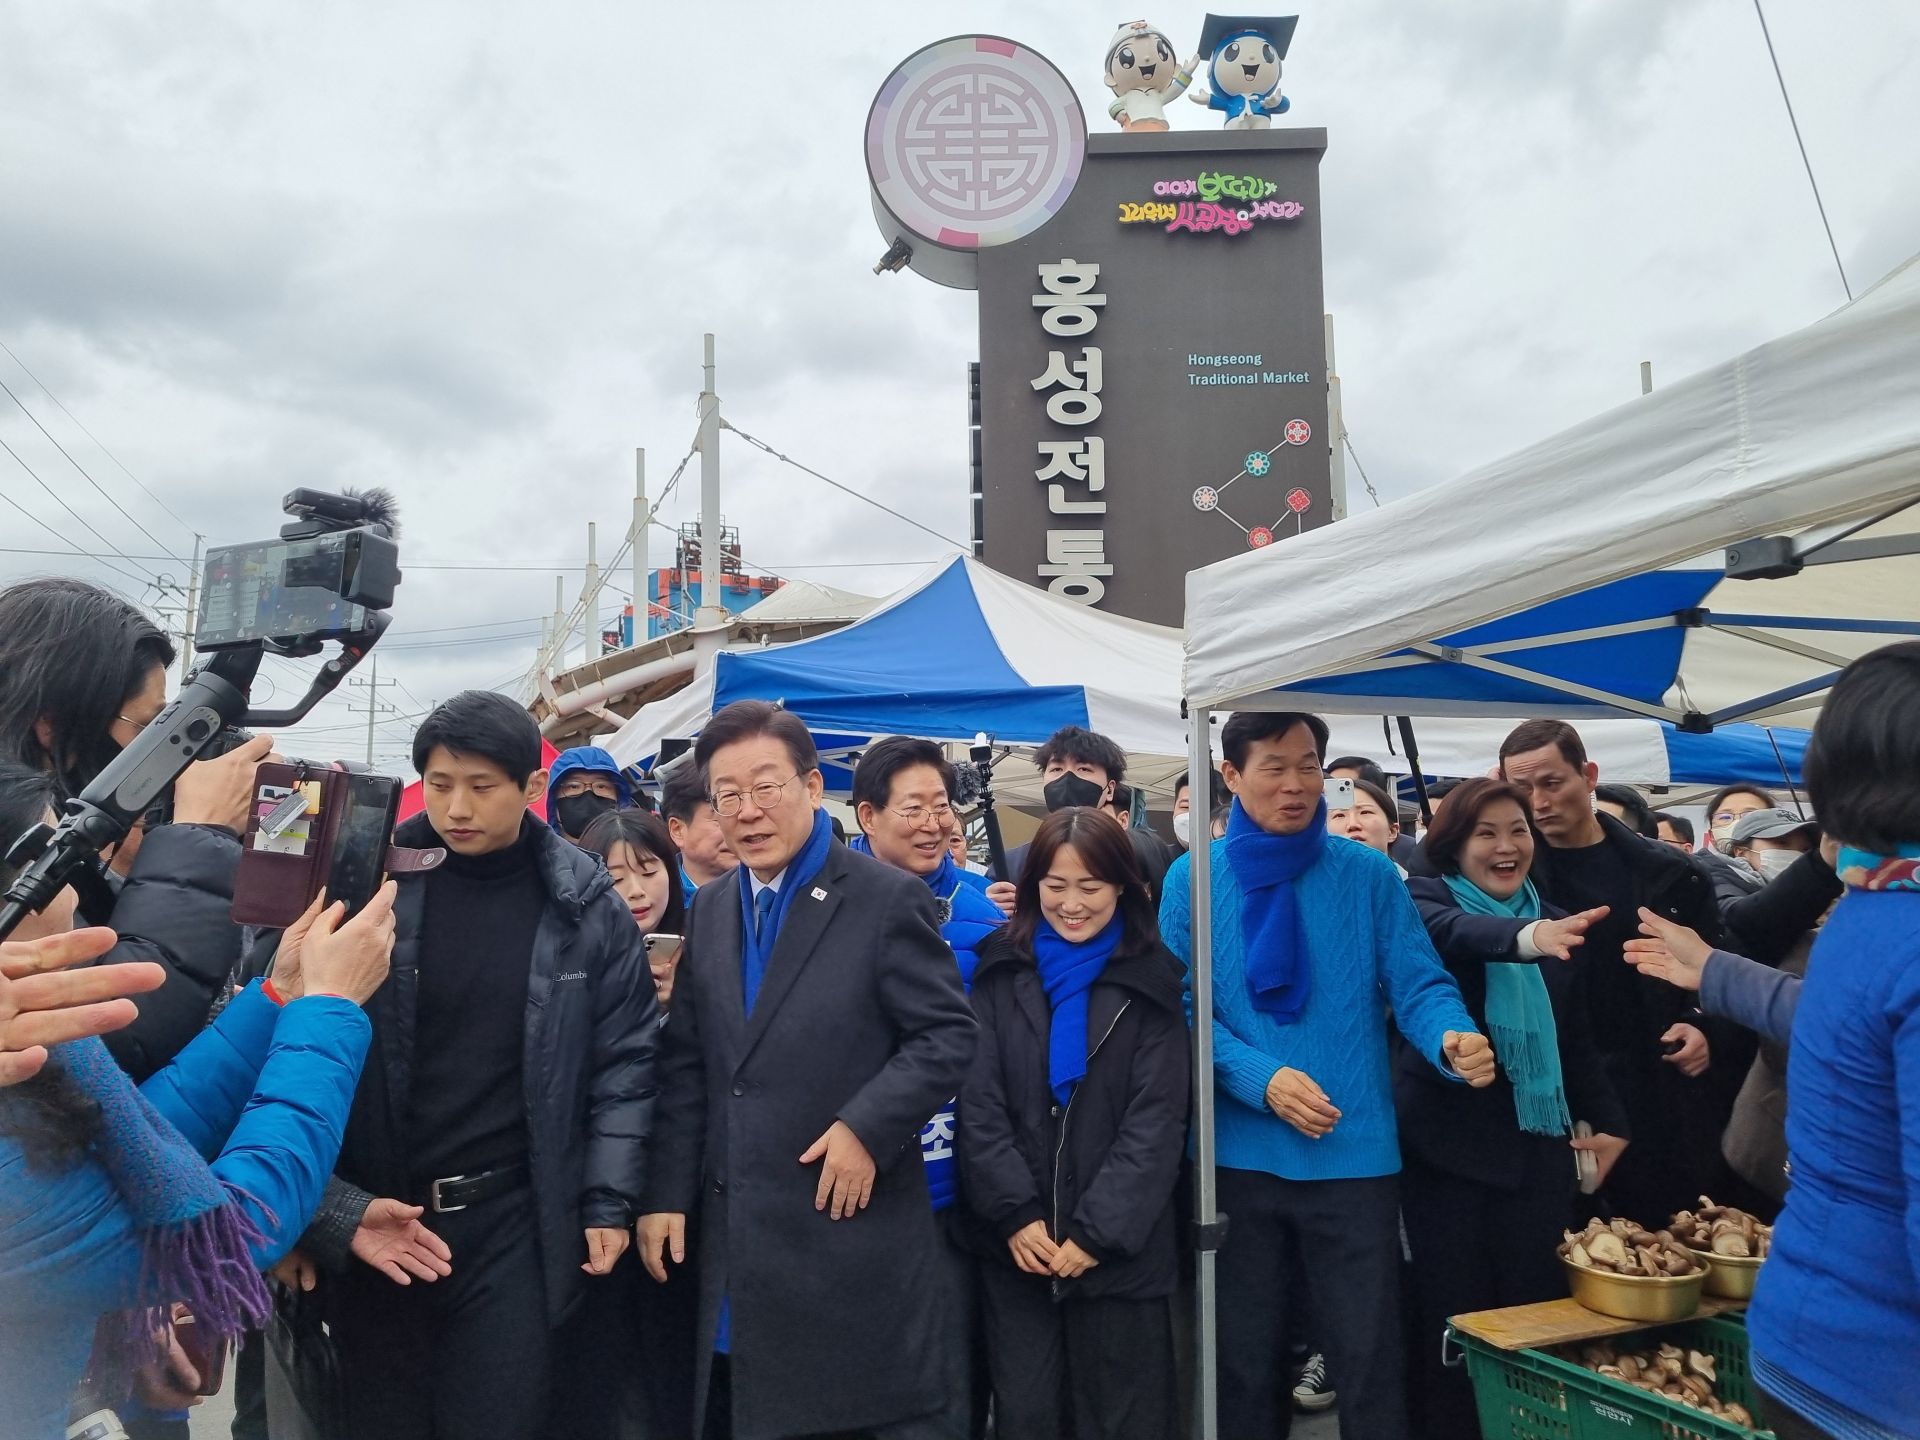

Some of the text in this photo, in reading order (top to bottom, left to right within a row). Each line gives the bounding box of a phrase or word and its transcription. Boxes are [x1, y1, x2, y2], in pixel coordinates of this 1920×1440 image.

[1154, 179, 1197, 196] 이야기
[1188, 353, 1262, 366] Hongseong
[1188, 371, 1310, 385] Traditional Market
[1030, 258, 1114, 606] 홍성전통
